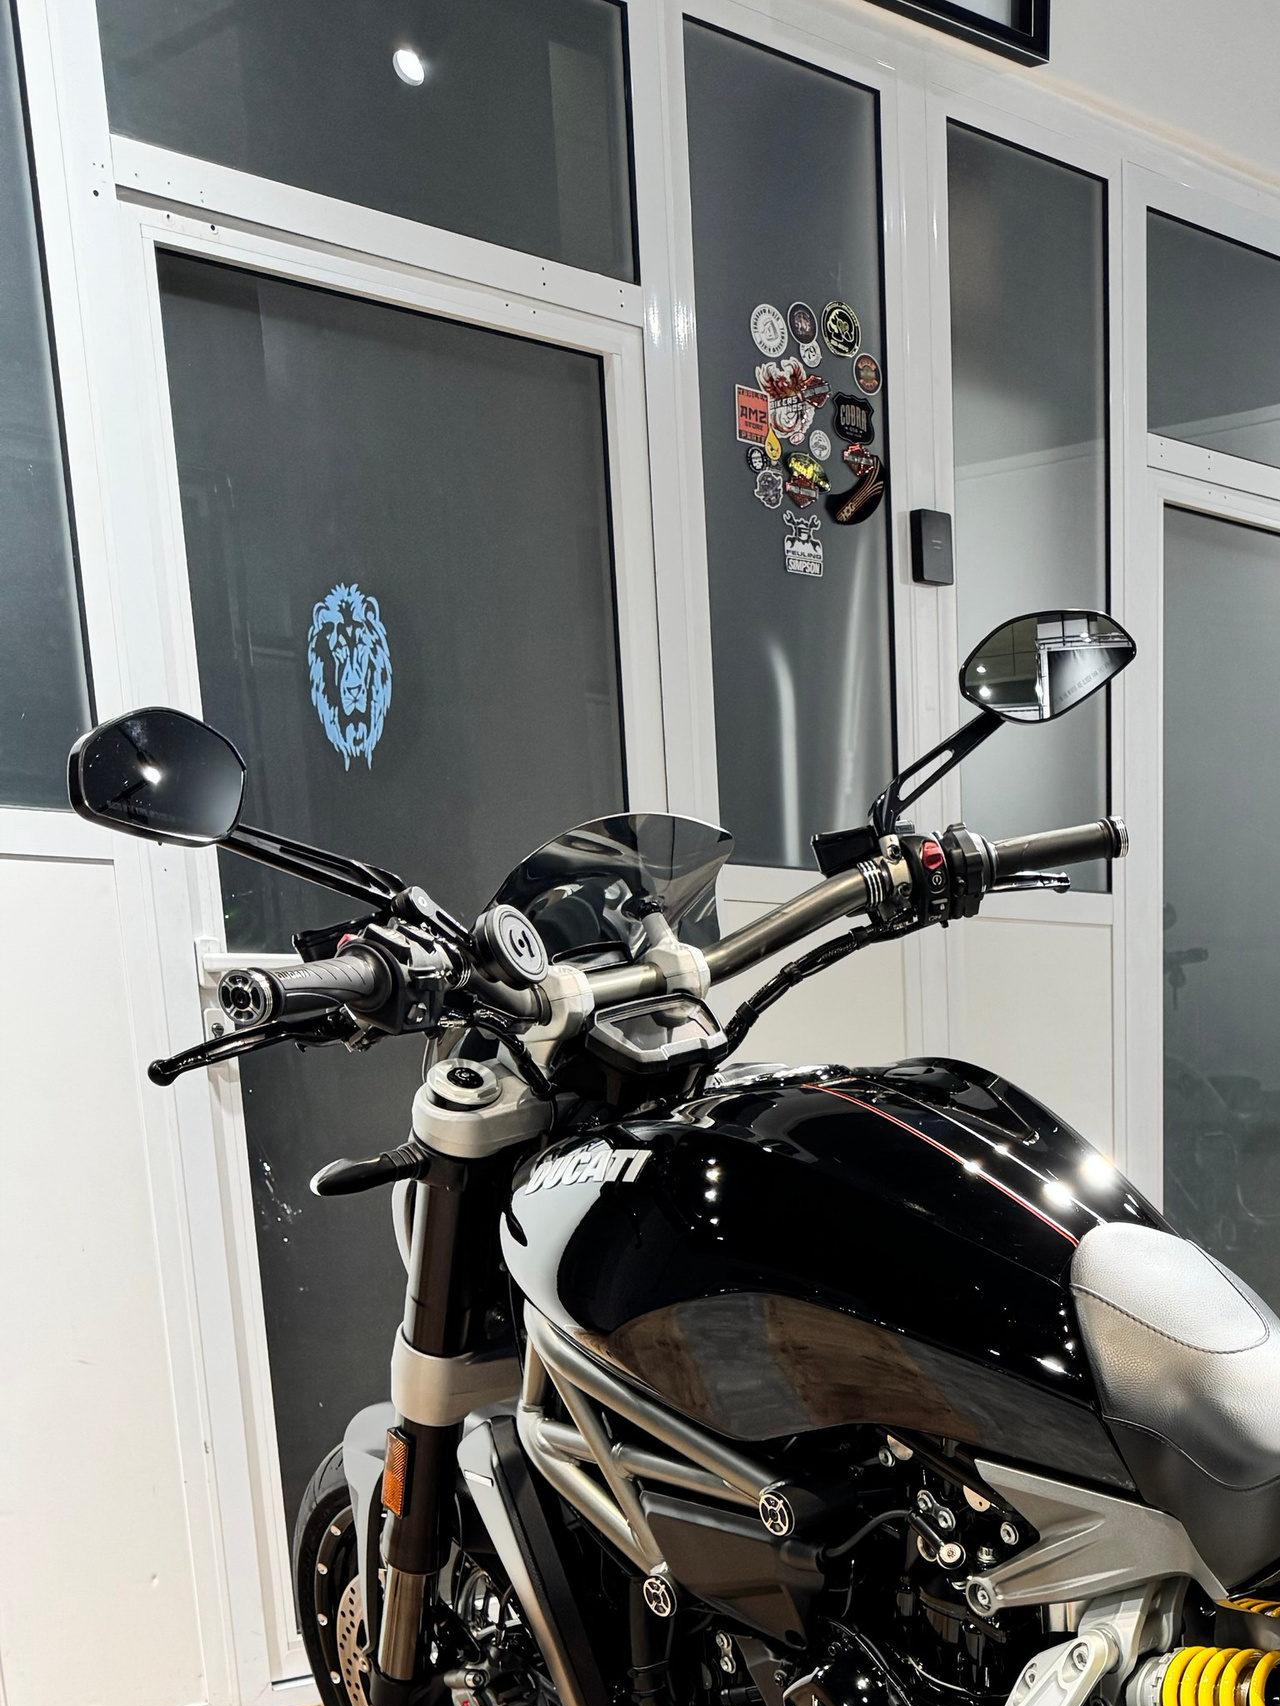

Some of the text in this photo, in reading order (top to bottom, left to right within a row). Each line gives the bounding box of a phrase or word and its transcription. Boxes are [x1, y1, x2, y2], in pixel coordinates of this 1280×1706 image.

[840, 404, 867, 432] COBRA
[786, 549, 822, 560] FEULING
[788, 559, 821, 575] SIMPSON
[525, 1149, 653, 1195] DUCATI
